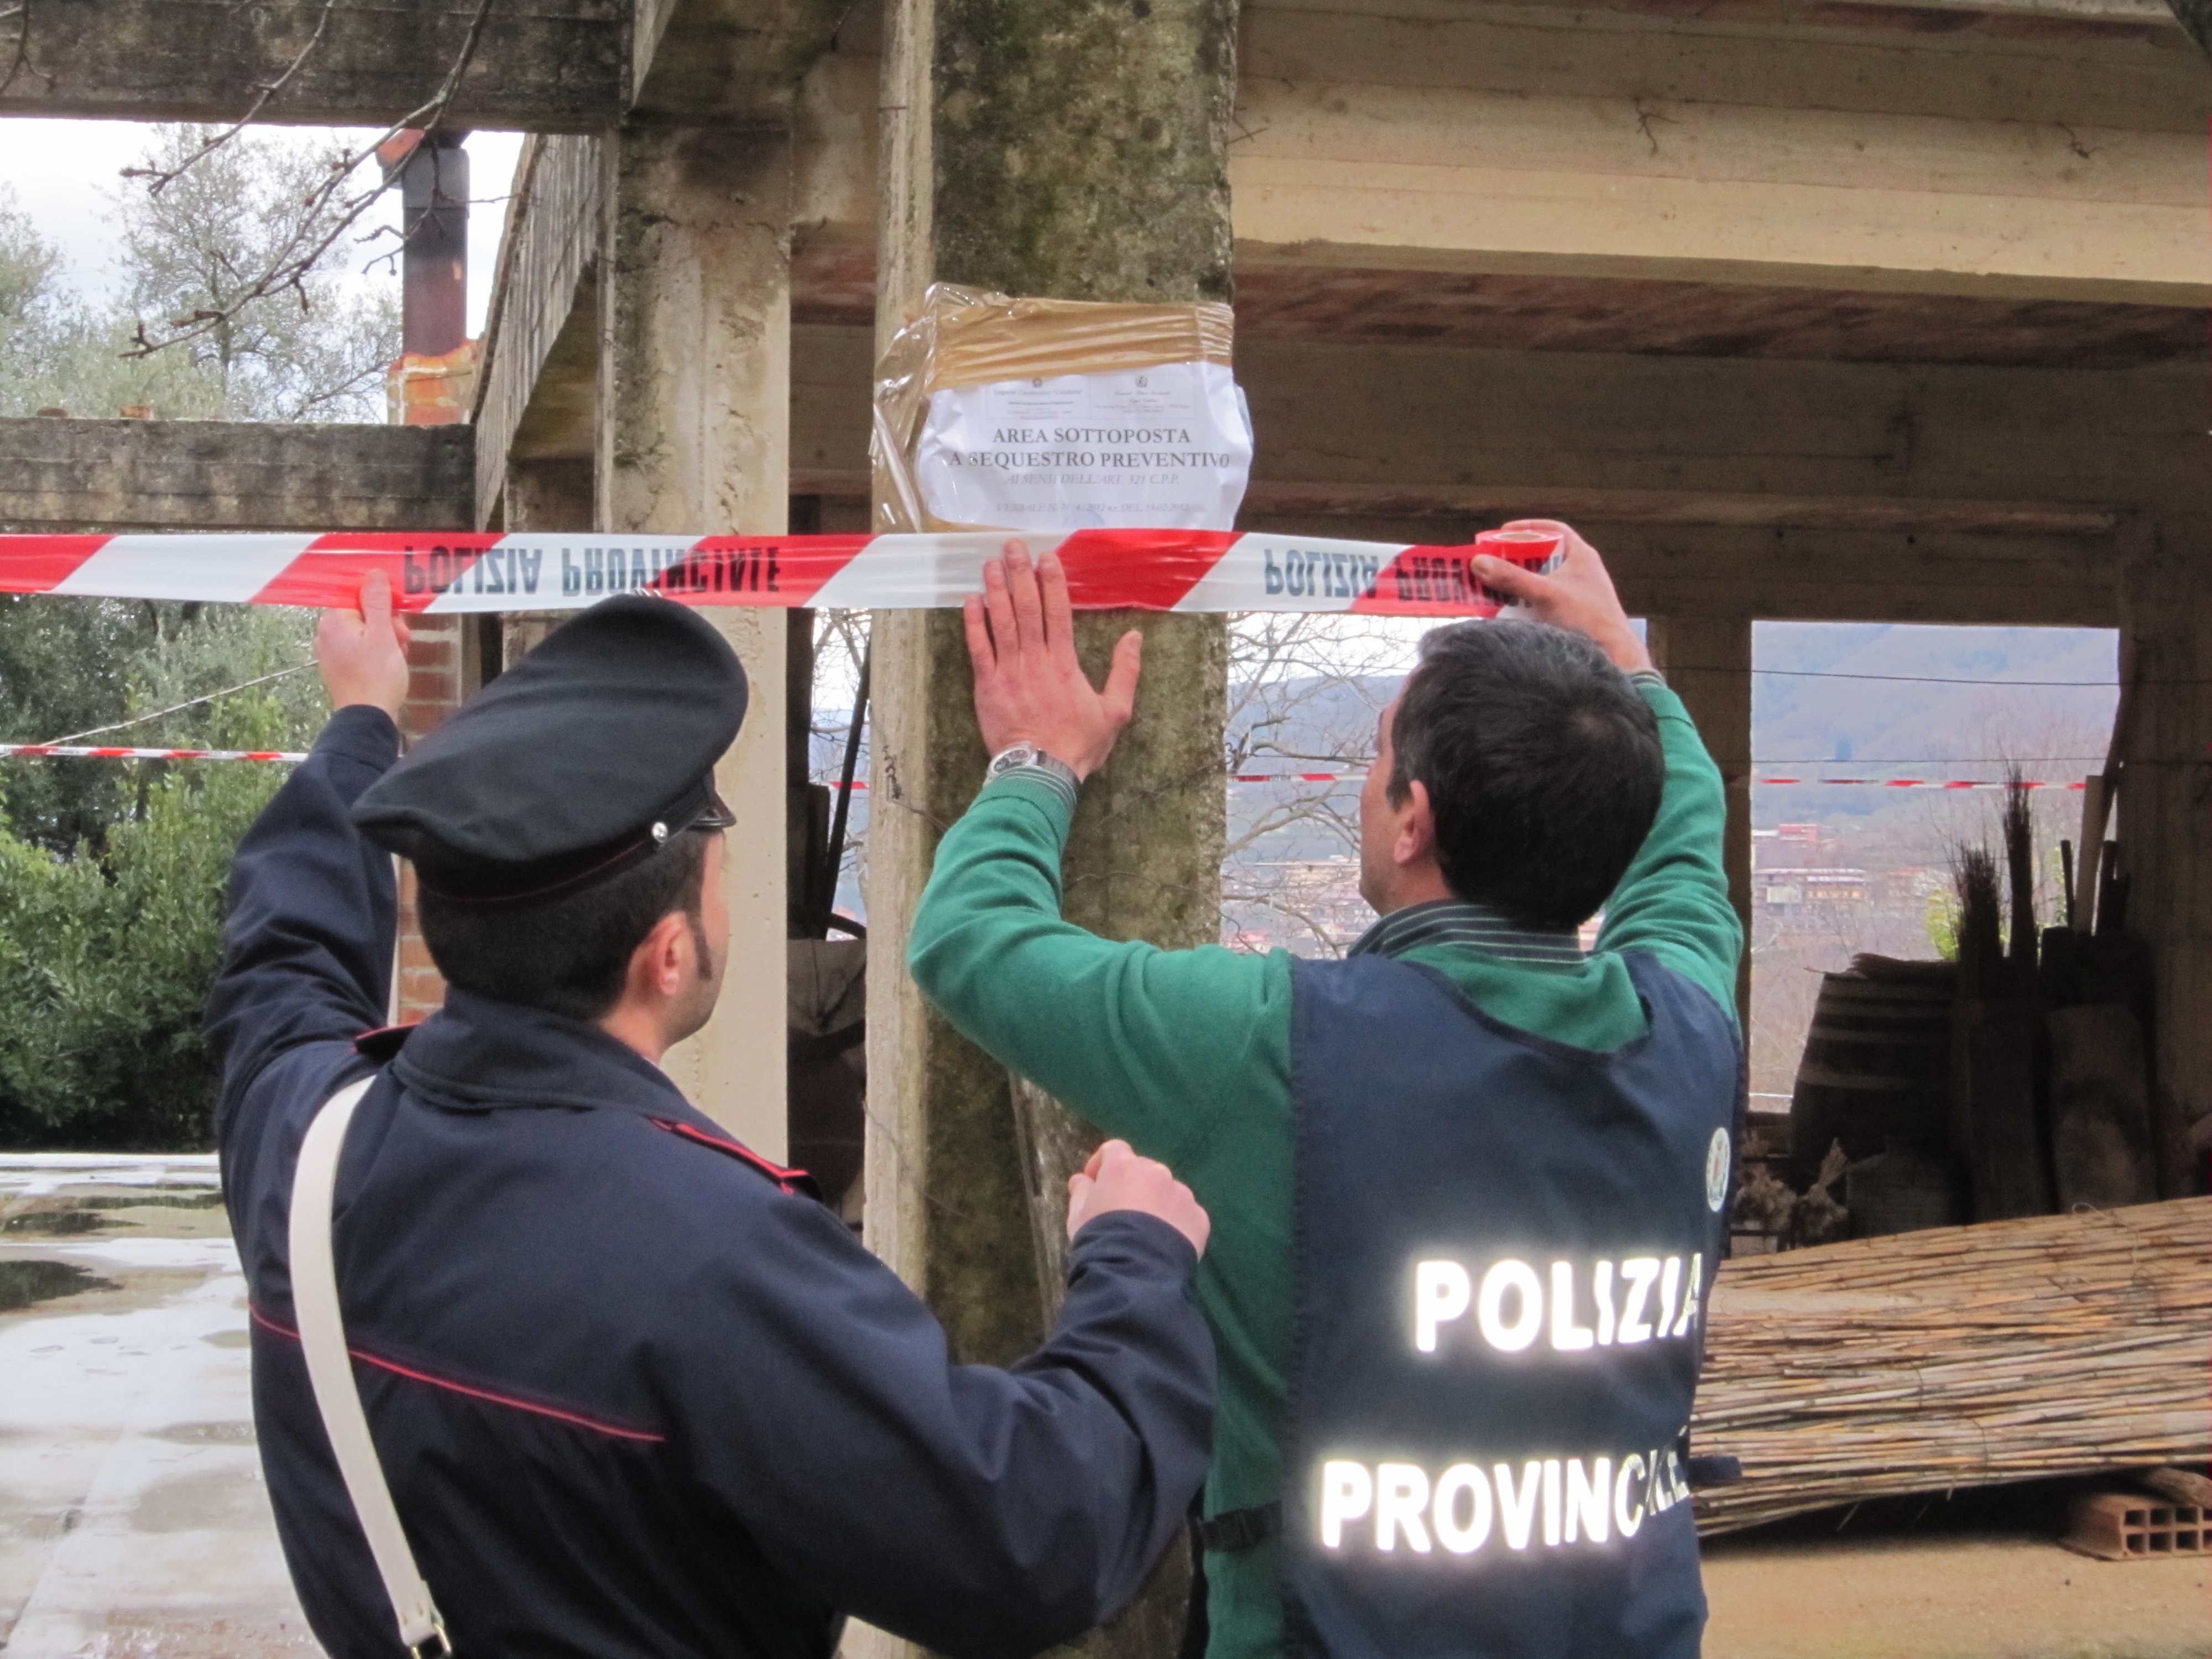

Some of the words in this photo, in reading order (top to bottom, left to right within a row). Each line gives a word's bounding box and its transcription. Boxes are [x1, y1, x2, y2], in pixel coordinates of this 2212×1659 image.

[993, 428, 1048, 443] AREA
[1054, 427, 1191, 444] SOTTOPOSTA
[950, 452, 963, 466] A
[968, 452, 1094, 469] SEQUESTRO
[1100, 452, 1229, 468] PREVENTIVO
[1416, 1253, 1702, 1352] POLIZIA
